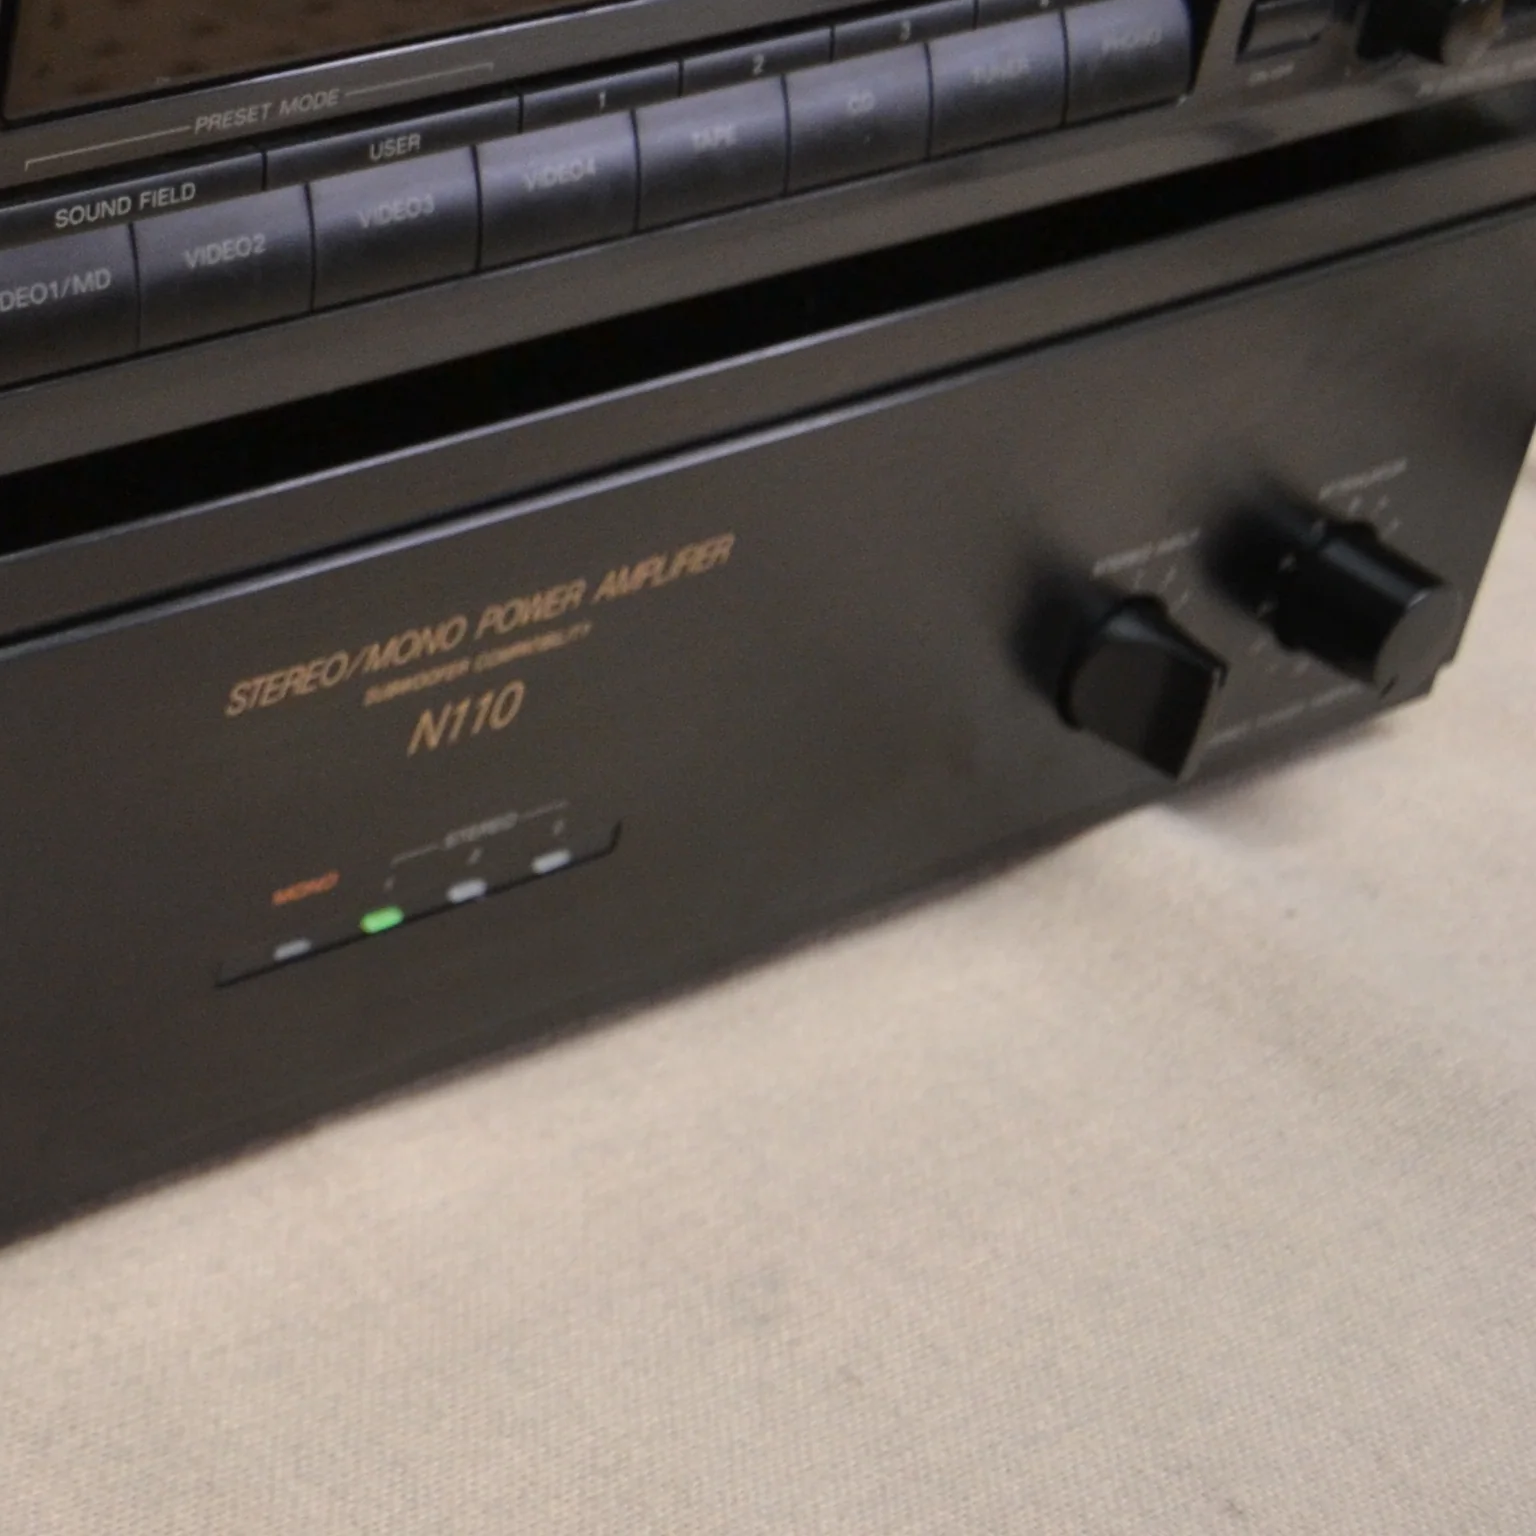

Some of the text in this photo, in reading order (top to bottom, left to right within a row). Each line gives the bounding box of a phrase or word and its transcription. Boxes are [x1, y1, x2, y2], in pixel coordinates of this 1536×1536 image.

[752, 54, 766, 75] 2
[194, 88, 340, 135] PRESET MODE
[369, 134, 422, 162] USER
[525, 157, 597, 192] VIDEO4
[54, 182, 197, 230] SOUND FIELD
[357, 193, 436, 229] VIDEO3
[183, 233, 268, 269] VIDEO2
[224, 531, 737, 720] STEREO/MONO POWER AMPLIFIER
[406, 679, 527, 758] N110
